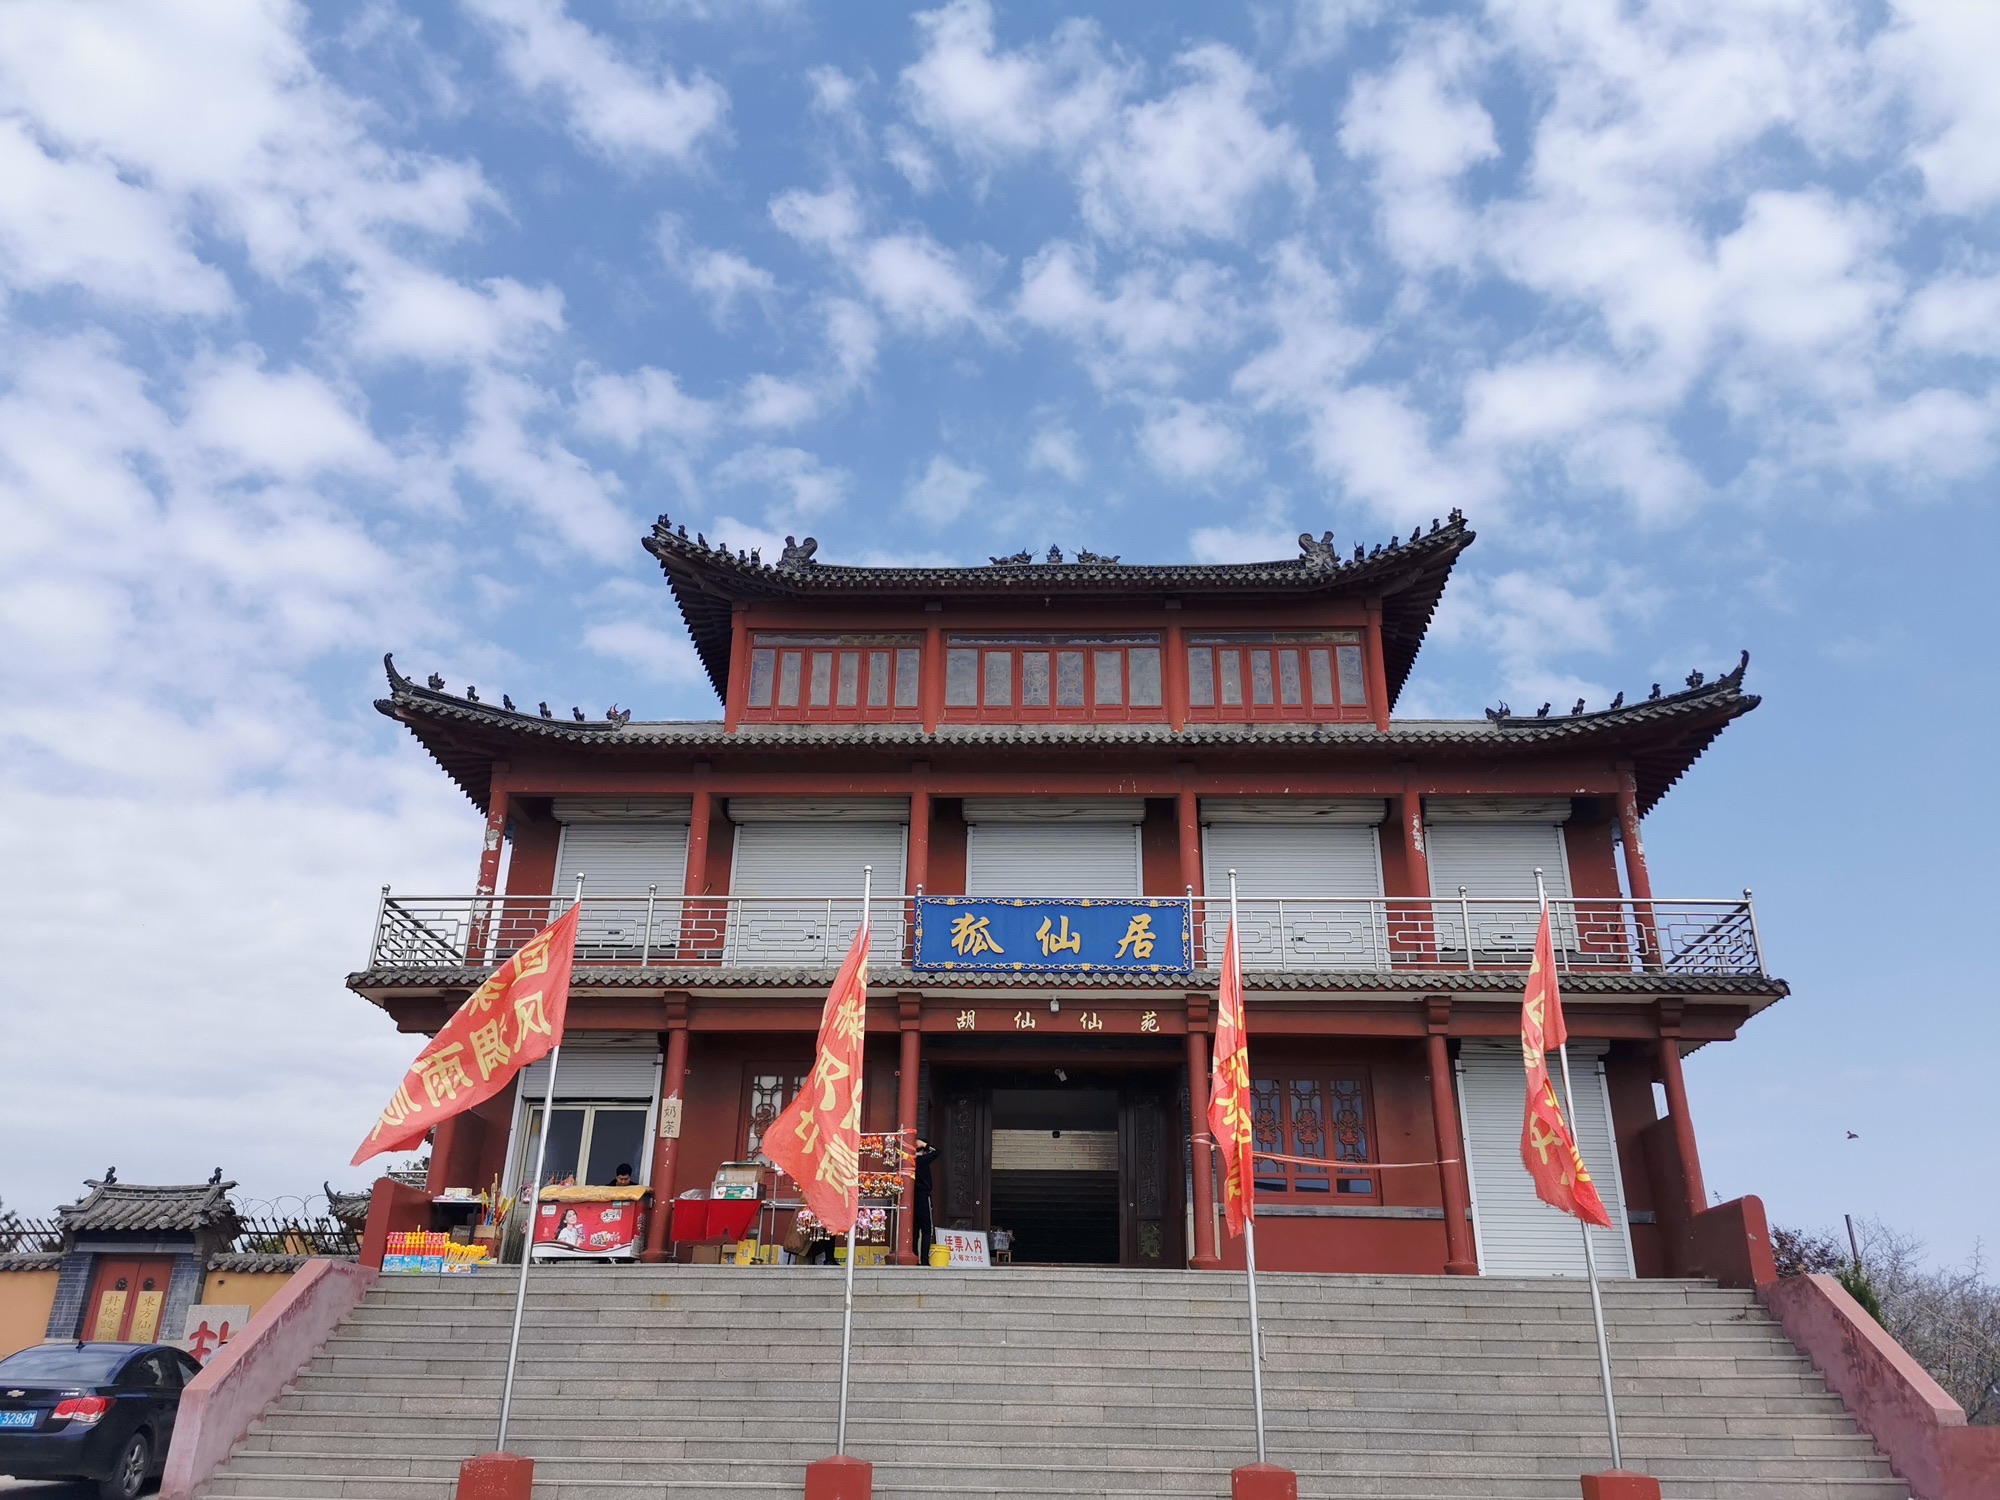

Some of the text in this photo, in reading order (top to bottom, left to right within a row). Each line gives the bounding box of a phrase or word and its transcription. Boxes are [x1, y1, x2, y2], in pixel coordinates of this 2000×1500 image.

[949, 911, 1158, 960] 狐仙居
[956, 1009, 1161, 1033] 胡仙仙苑
[663, 1105, 677, 1134] 奶茶
[944, 1235, 983, 1254] 凭票入内
[1, 1412, 36, 1424] 3286M
